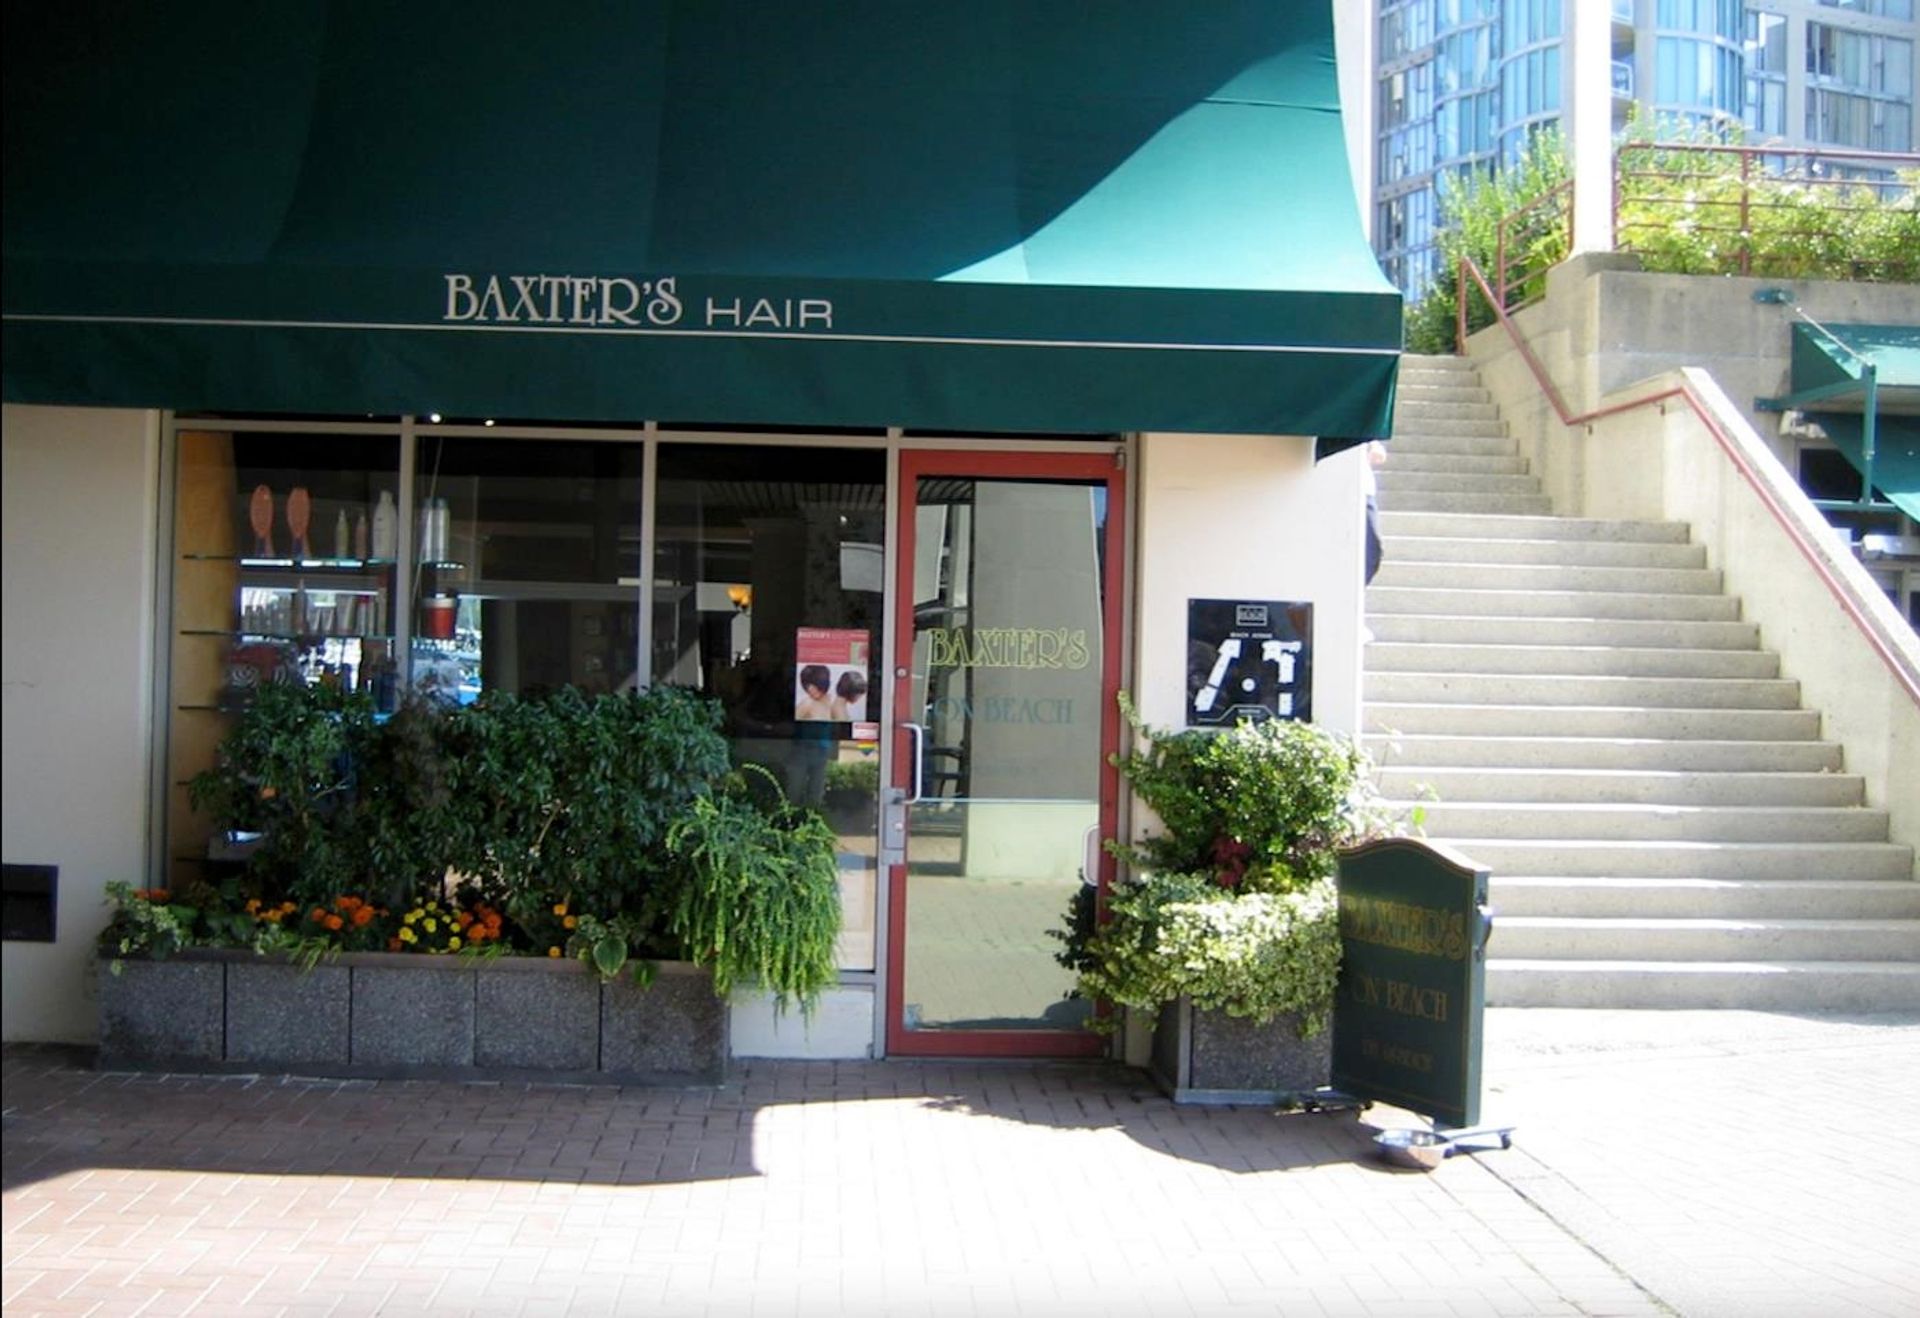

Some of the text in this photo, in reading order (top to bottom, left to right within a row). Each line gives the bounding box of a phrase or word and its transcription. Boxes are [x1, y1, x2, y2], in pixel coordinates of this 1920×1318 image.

[443, 274, 833, 328] BAXTER'S HAIR
[926, 627, 1091, 670] BAXTER'S
[933, 696, 1074, 725] ON BEACH
[1386, 981, 1448, 1022] BEACH
